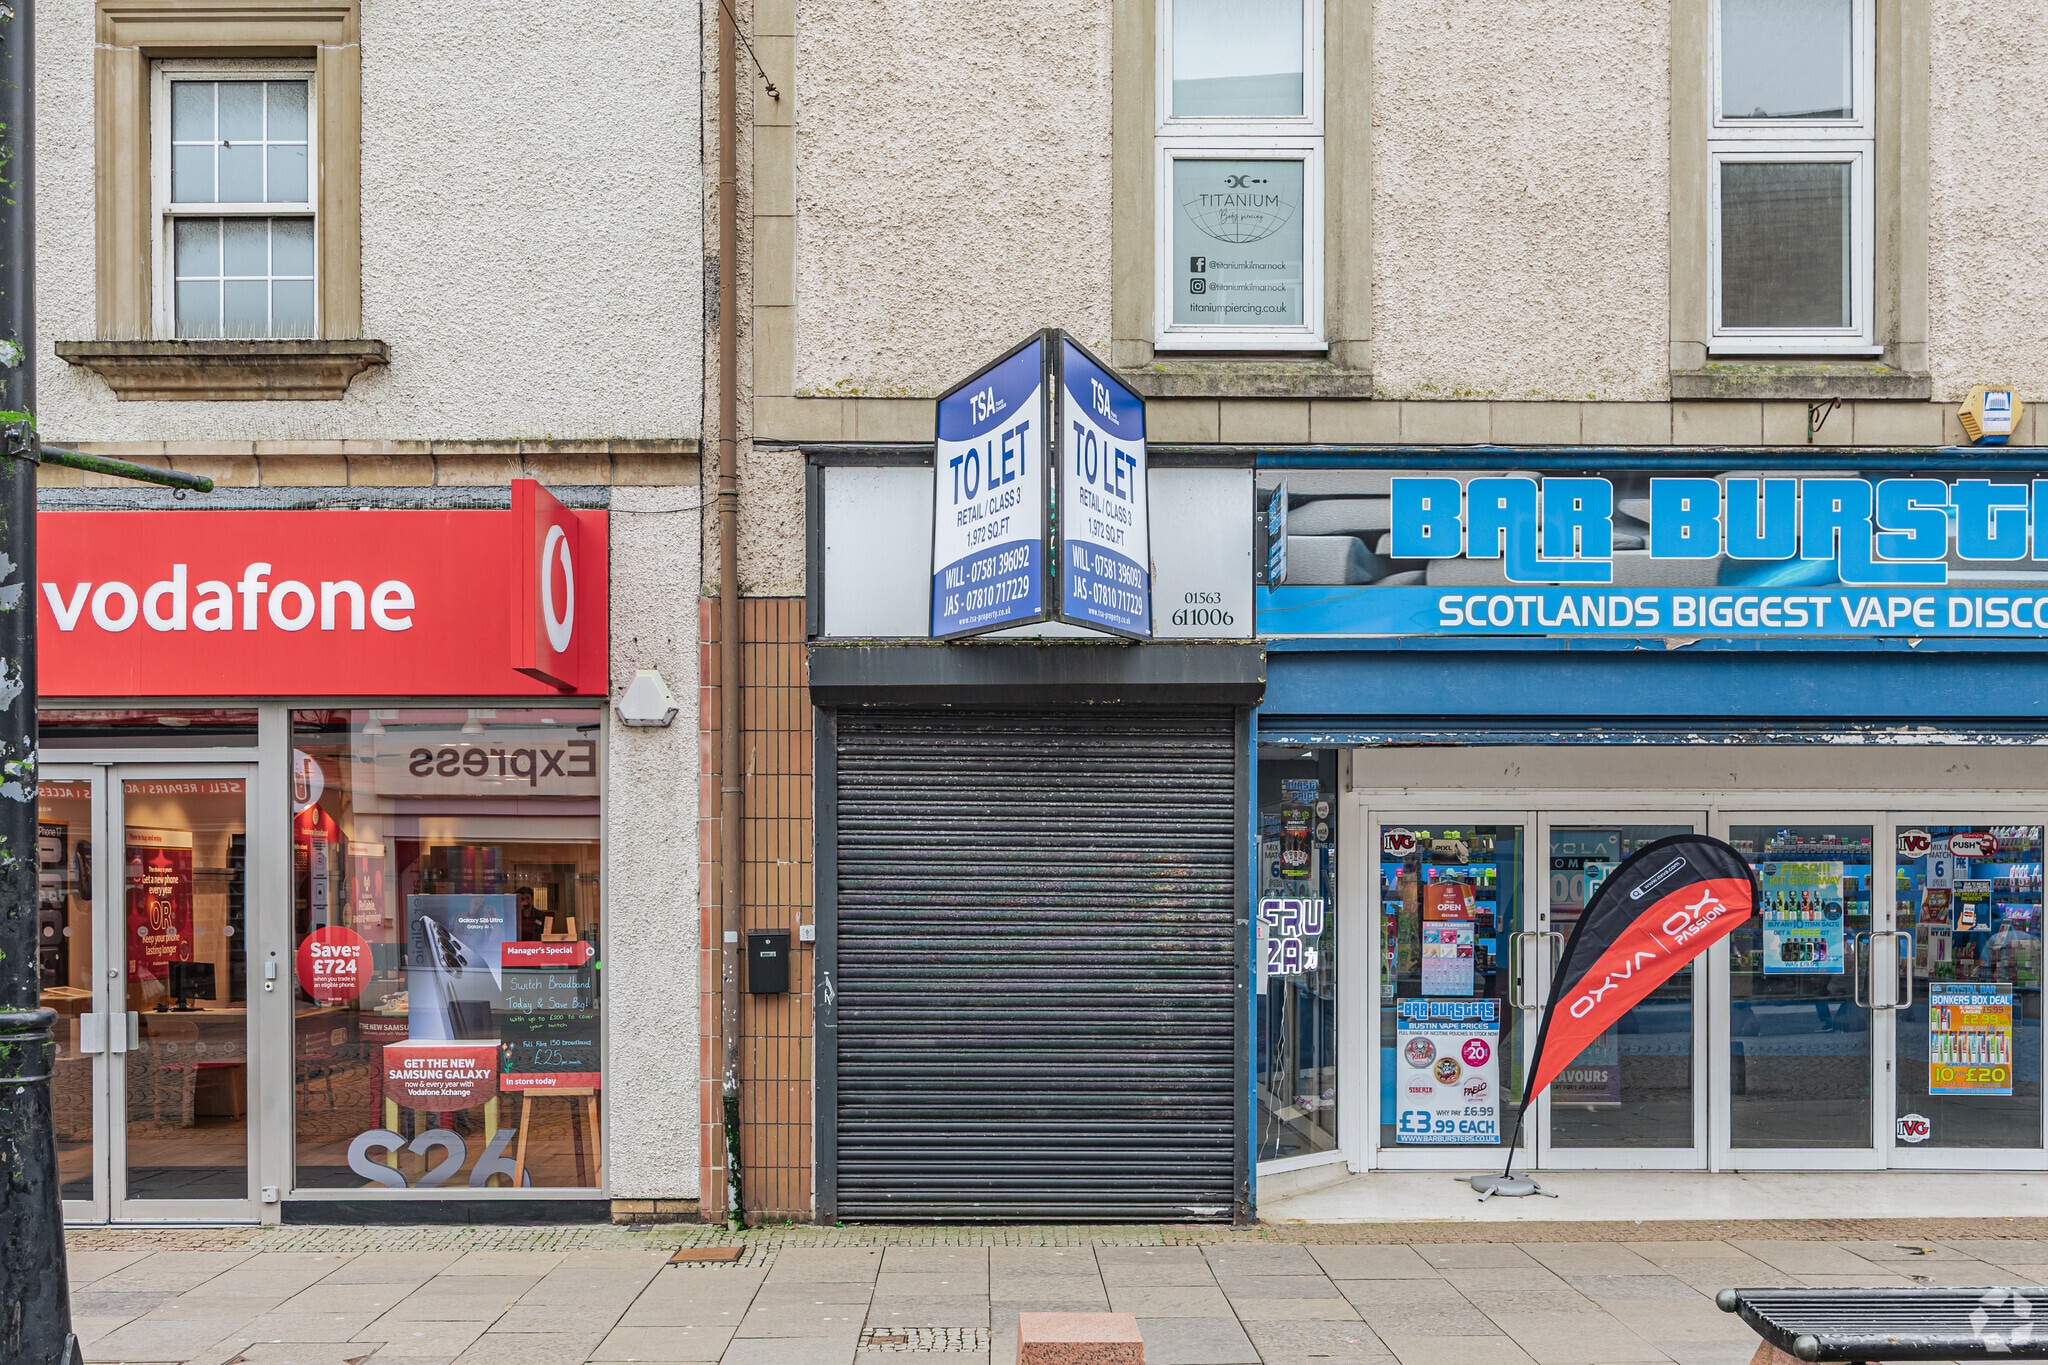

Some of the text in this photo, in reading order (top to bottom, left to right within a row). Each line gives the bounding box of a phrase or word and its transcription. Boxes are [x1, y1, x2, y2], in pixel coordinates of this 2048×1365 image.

[1200, 194, 1279, 207] TITANIUM
[1209, 260, 1286, 270] @titaniumkilmarnock
[1209, 282, 1286, 292] @titaniumkilmarnock
[1190, 302, 1287, 315] titaniumpiercing.co.uk
[969, 386, 995, 425] TSA
[1091, 378, 1111, 420] TSA
[950, 420, 1029, 505] TO LET
[1073, 420, 1137, 504] TO LET
[957, 502, 983, 527] RETAIL
[990, 492, 1014, 515] CLASS
[1080, 486, 1101, 513] RETAIL
[1106, 500, 1127, 524] CLASS
[967, 516, 1010, 549] 1,972 SQ.FT
[1088, 517, 1125, 546] 1,972 SQ.FT
[1390, 477, 1613, 583] BAR
[945, 545, 1029, 589] WILL 07581 396092
[1072, 544, 1142, 589] WILL 07581 396092
[41, 562, 416, 632] vodafone
[944, 575, 1029, 617] JAS 07810 717229
[1073, 575, 1143, 616] JAS 07810 717229
[1184, 591, 1221, 604] 01563
[959, 606, 1011, 625] www.tsa-property.co.uk
[1088, 607, 1131, 625] www.tsa-property.co.uk
[1171, 608, 1234, 626] 611006
[1438, 595, 1659, 628] SCOTLANDS
[1672, 595, 1832, 628] BIGGEST
[1840, 596, 1936, 628] VAPE
[1384, 834, 1416, 850] IVG
[1899, 836, 1930, 852] IVG
[1271, 861, 1280, 878] 6
[1643, 860, 1680, 890] www.oxva.com
[1781, 863, 1831, 875] FREE!!!
[1935, 860, 1944, 877] 6
[164, 876, 178, 886] phone
[1770, 876, 1840, 885] KIT GIVEAWAY
[149, 886, 172, 896] every year
[150, 901, 172, 930] OR
[1674, 903, 1727, 946] PASSION
[1792, 928, 1821, 936] FREE
[1794, 920, 1804, 928] 10
[155, 935, 165, 944] your
[146, 945, 177, 956] lasting longer
[310, 942, 351, 957] Save
[508, 947, 573, 955] Manager's Special
[313, 960, 357, 975] £724
[511, 975, 591, 991] Switch Broadband
[1946, 985, 1996, 994] CRYSTAL BAR
[505, 996, 533, 1014] Today
[548, 997, 568, 1009] Save
[572, 997, 589, 1012] Big!
[1932, 996, 2010, 1004] BONKERS BOX DEAL
[1403, 1002, 1495, 1021] BAR BURSTERS
[1962, 1014, 1998, 1024] £2.99
[534, 1048, 563, 1065] £25
[1467, 1047, 1485, 1060] 20
[404, 1059, 476, 1068] GET THE NEW
[389, 1070, 491, 1079] SAMSUNG GALAXY
[535, 1078, 557, 1086] today
[1556, 1070, 1608, 1083] AVOURS
[1936, 1068, 2006, 1082] 10 £20
[441, 1089, 471, 1098] Xchange
[1464, 1106, 1494, 1116] £6.99
[1399, 1110, 1495, 1133] £3.99 EACH
[1898, 1121, 1929, 1135] IVG
[347, 1128, 531, 1188] S26
